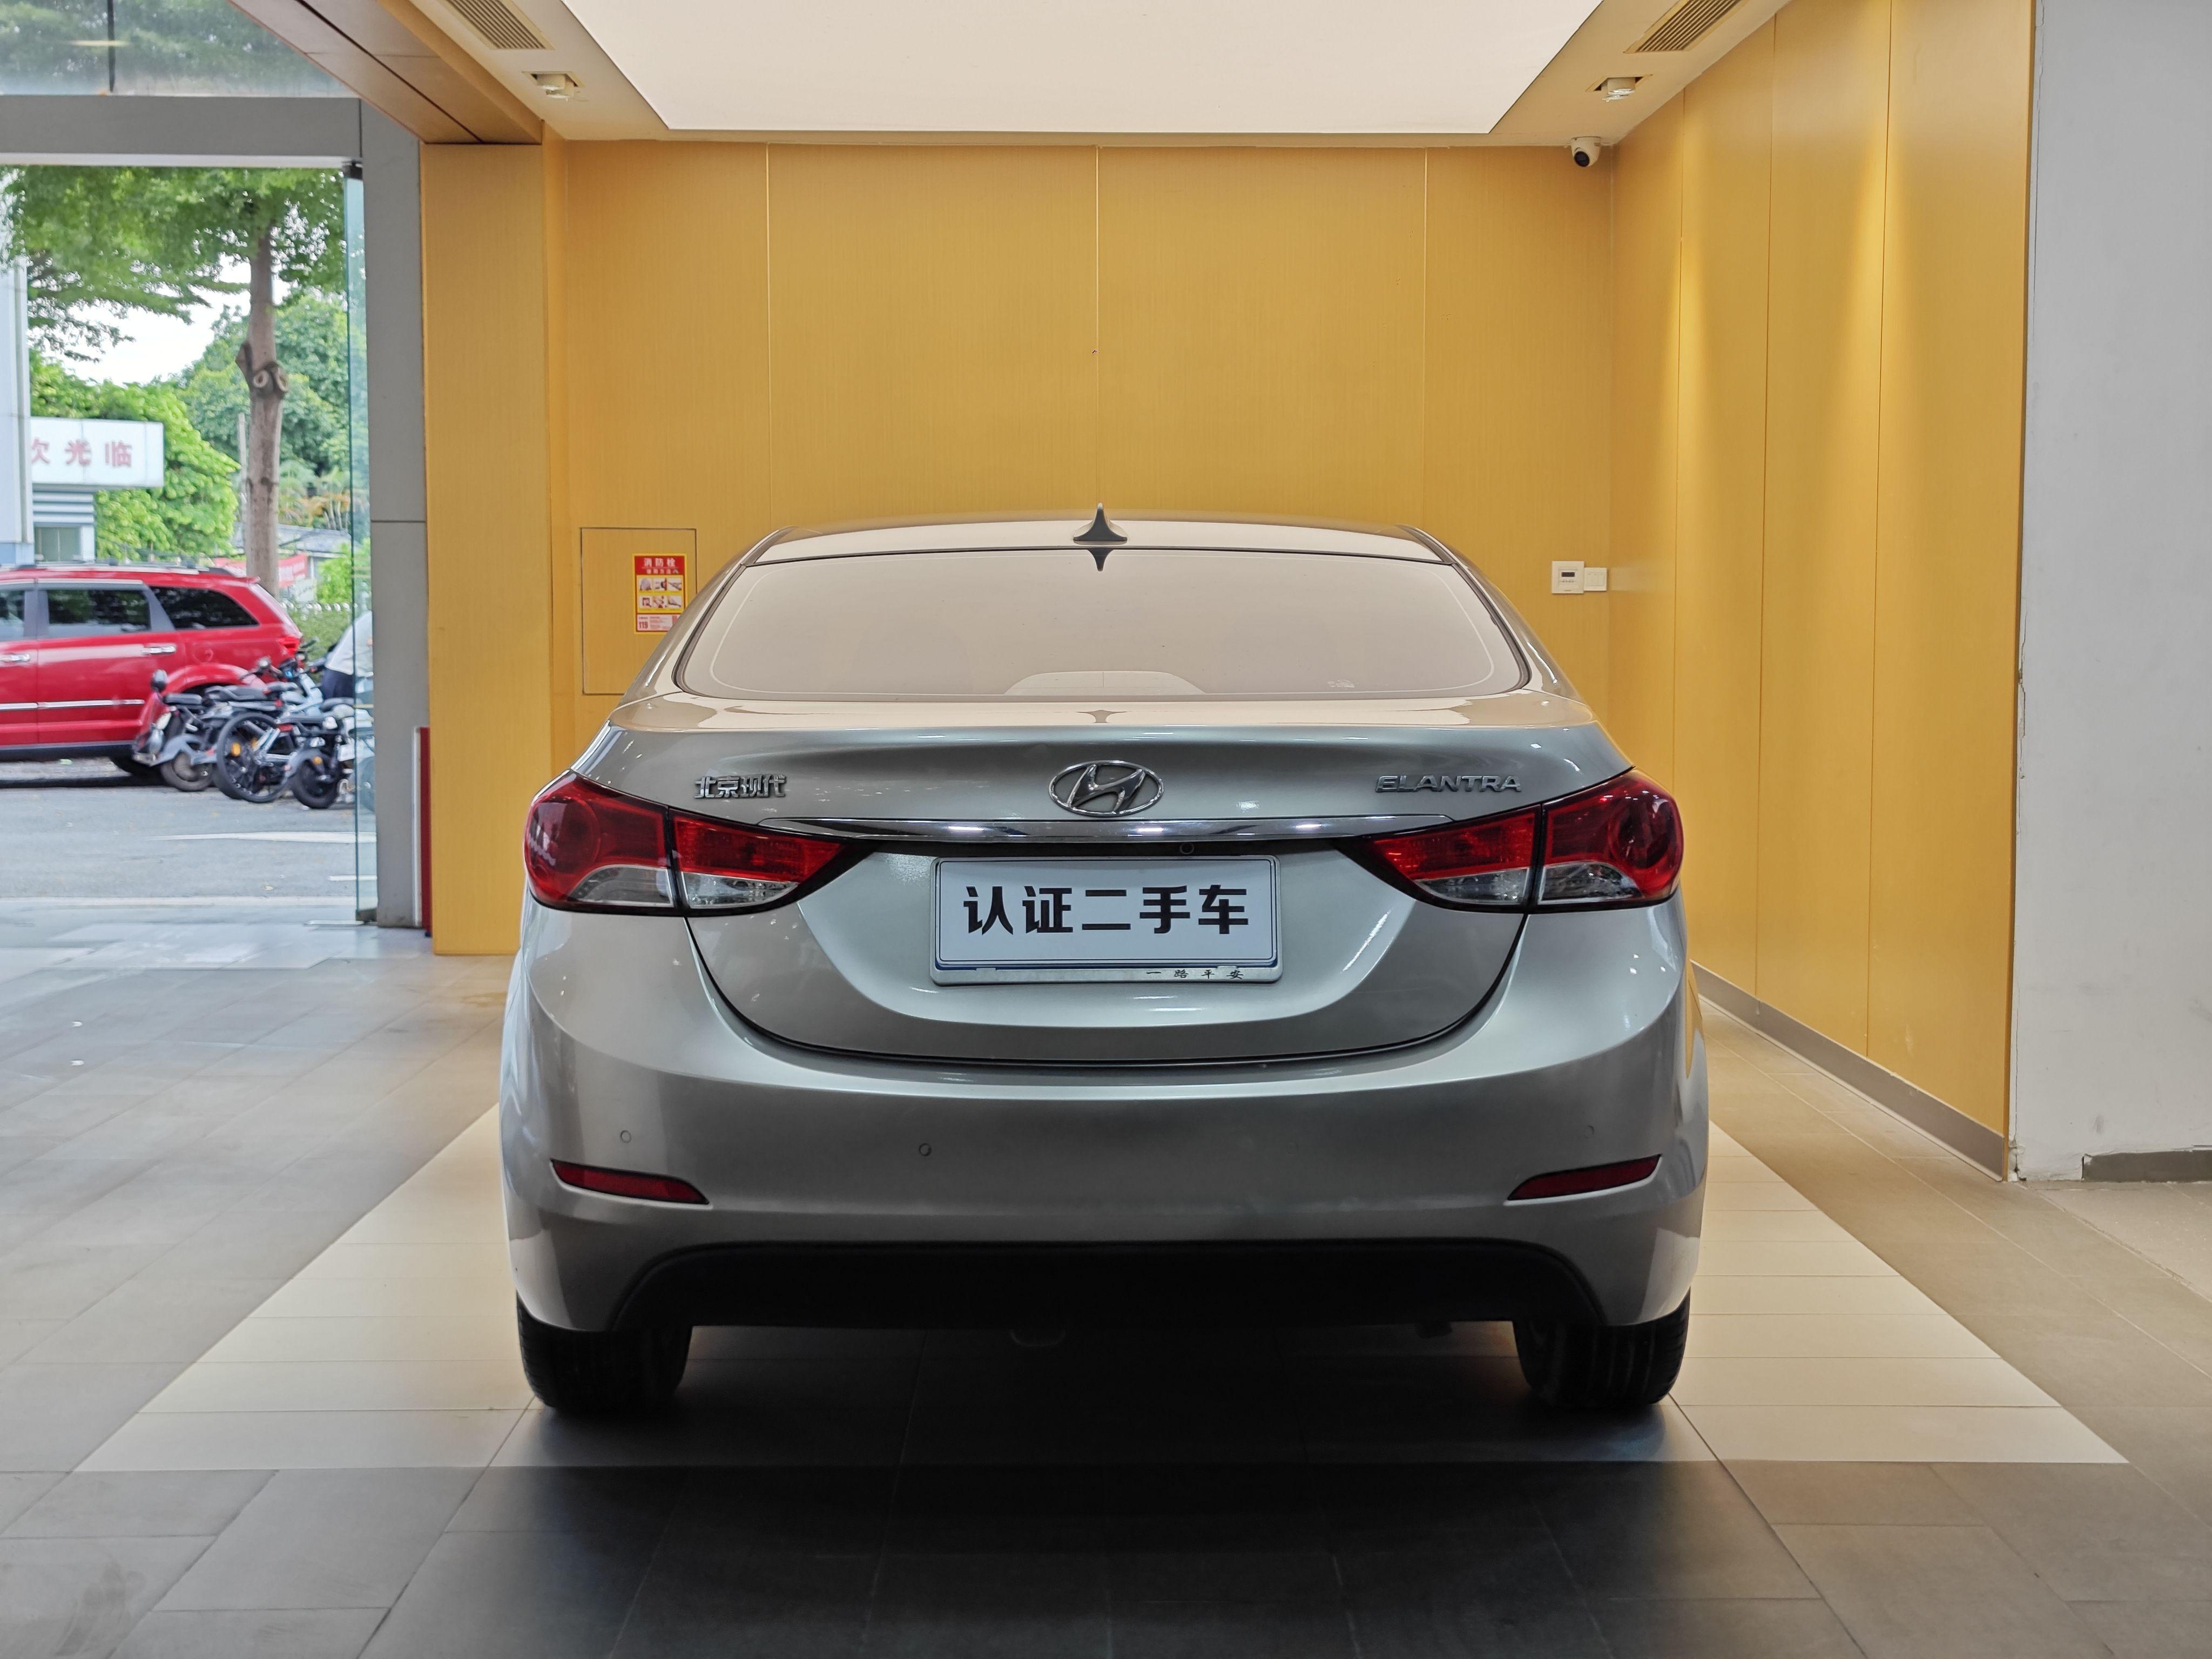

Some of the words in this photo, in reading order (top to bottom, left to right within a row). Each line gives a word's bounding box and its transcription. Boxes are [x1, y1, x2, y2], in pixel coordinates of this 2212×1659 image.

[694, 775, 786, 798] 北京现代
[1376, 775, 1522, 792] ELANTRA
[963, 885, 1249, 935] 认证二手车
[1147, 969, 1244, 979] 一路平安
